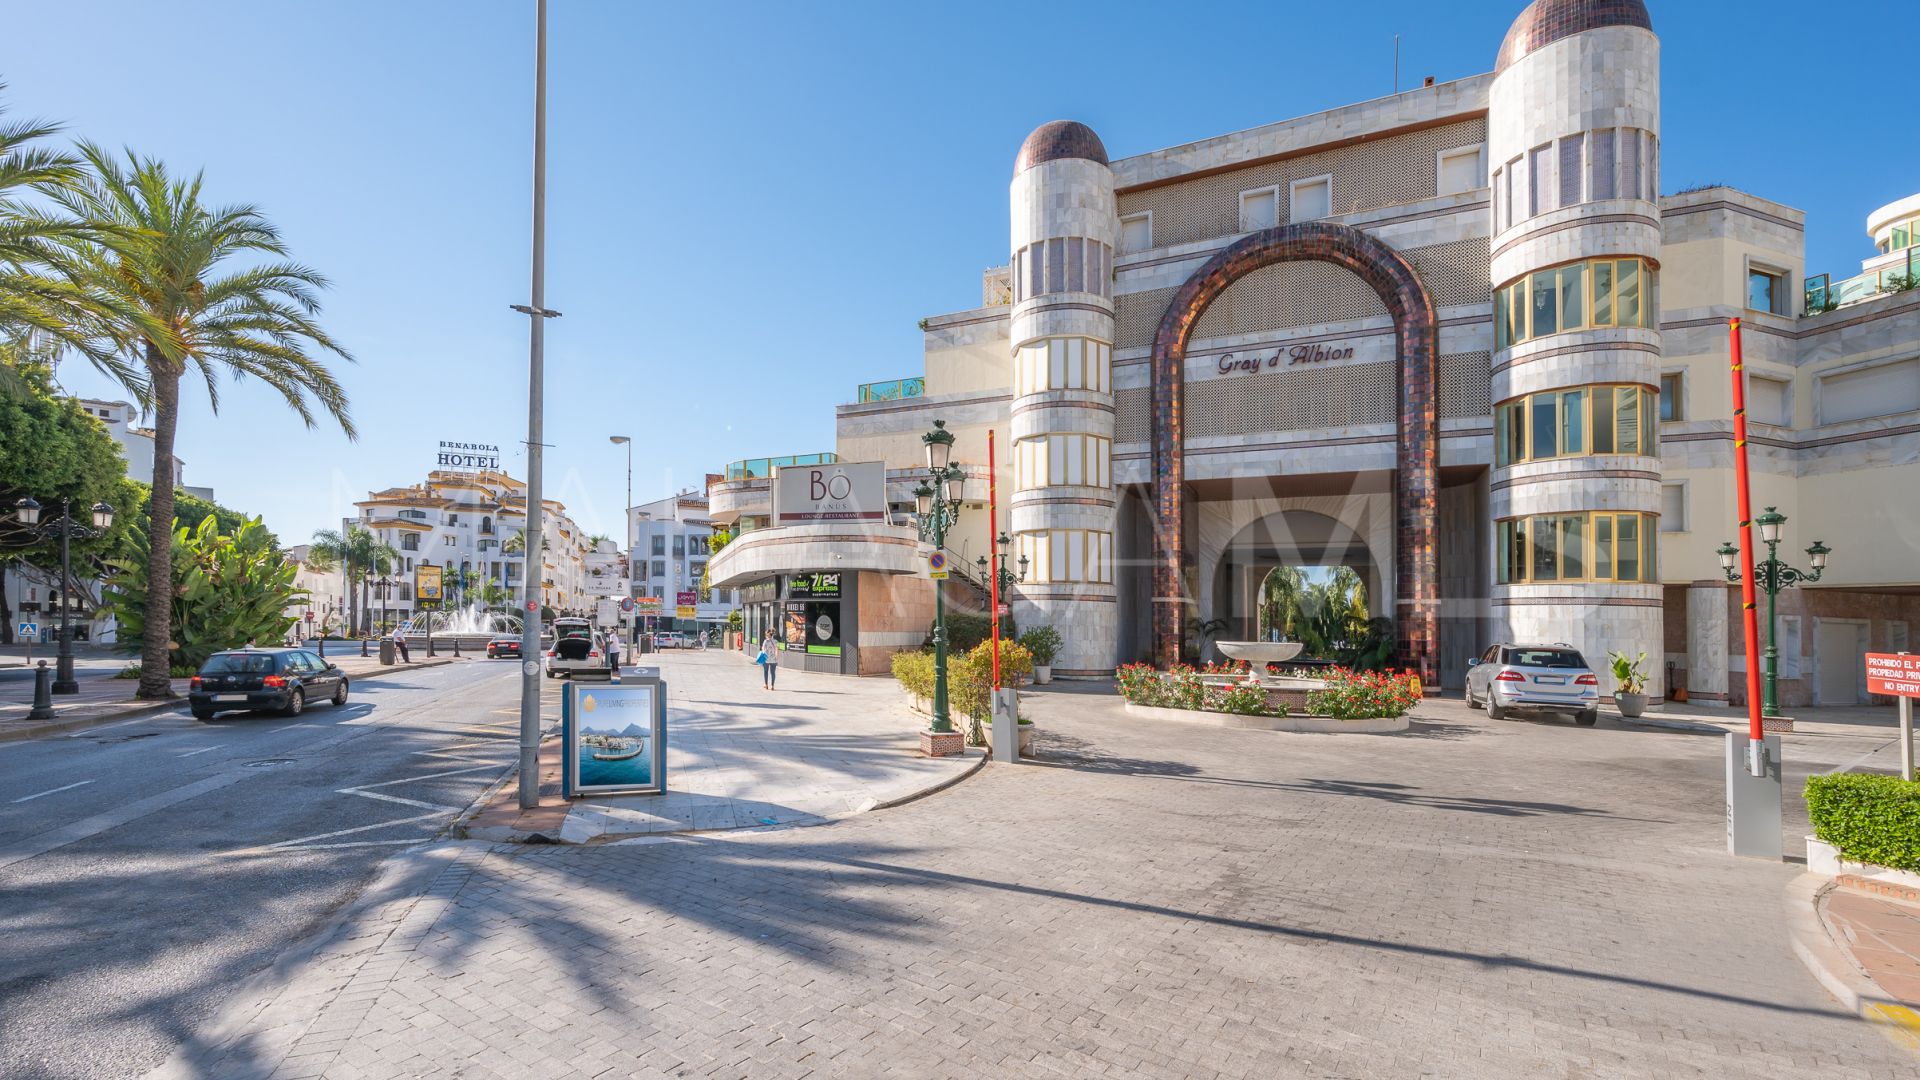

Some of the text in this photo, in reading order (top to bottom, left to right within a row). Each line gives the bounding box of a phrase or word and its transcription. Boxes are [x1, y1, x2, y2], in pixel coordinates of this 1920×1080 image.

[1218, 353, 1261, 375] Gray
[1288, 344, 1355, 366] Albion
[440, 440, 499, 452] BENABOLA
[437, 453, 500, 469] HOTEL
[1904, 660, 1914, 669] EL
[1868, 667, 1904, 678] PROPIEDAD
[1884, 681, 1920, 693] NO ENTRY
